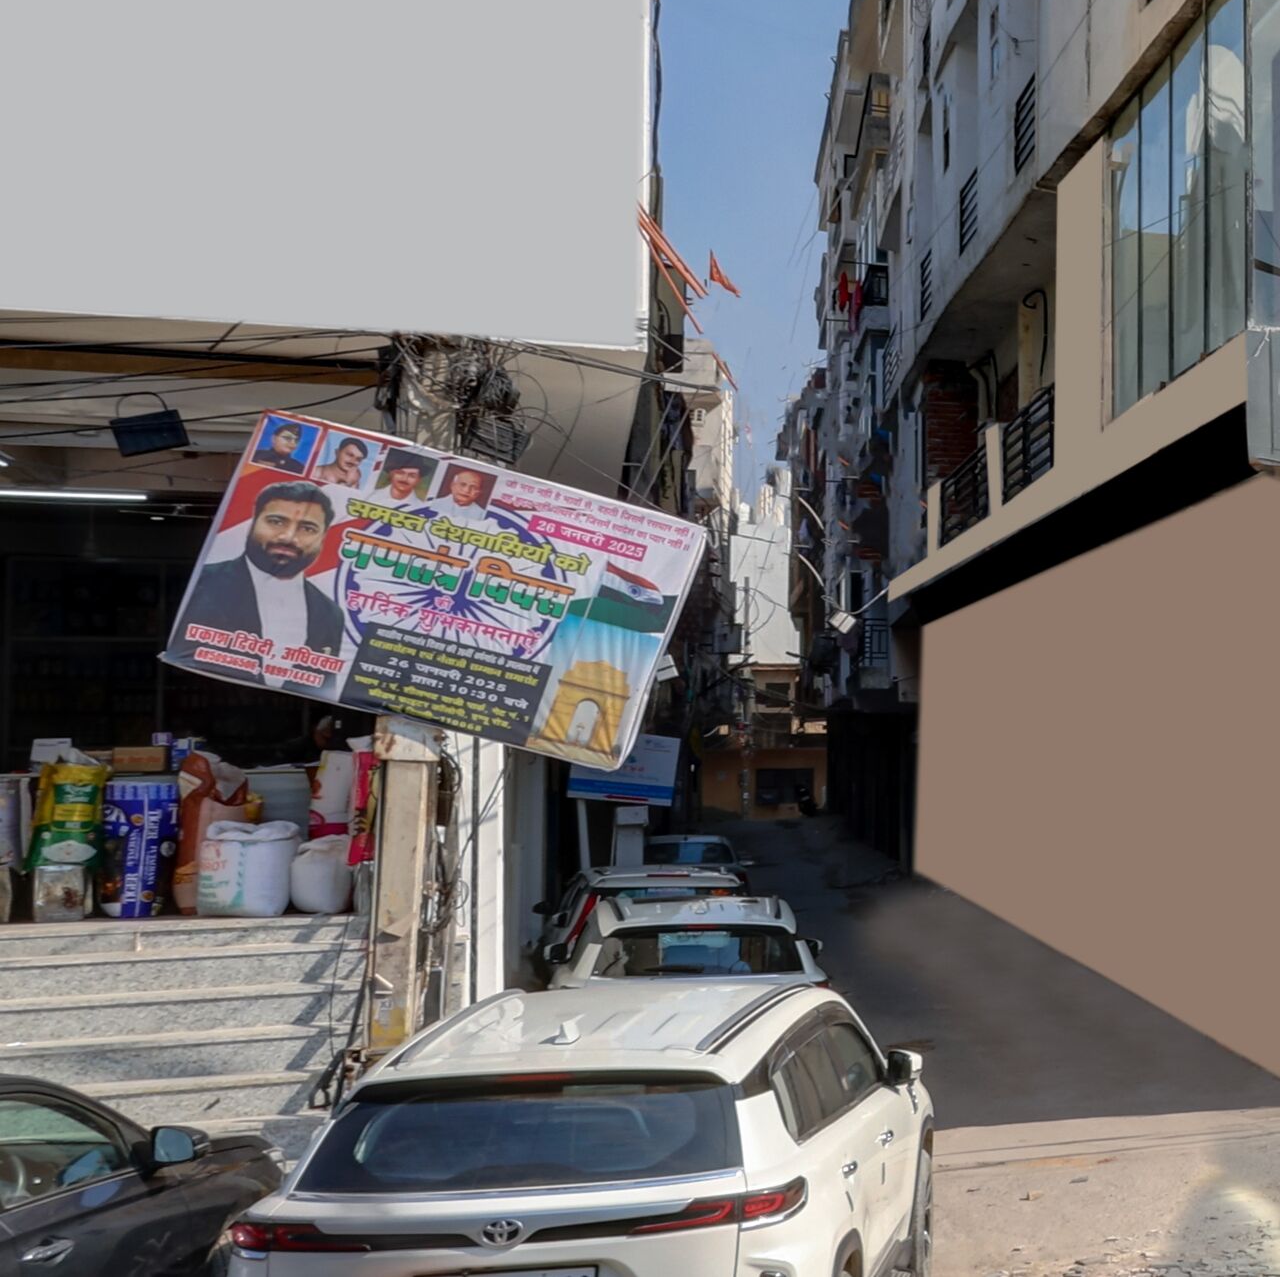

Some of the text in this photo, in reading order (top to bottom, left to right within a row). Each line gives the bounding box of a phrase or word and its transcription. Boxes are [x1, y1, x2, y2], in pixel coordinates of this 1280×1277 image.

[346, 498, 593, 575] समस्त देशवासियों को
[536, 519, 643, 558] 26 जनवरी 2025
[341, 531, 576, 618] गणतंत्र दिवस
[347, 590, 411, 619] हार्दिक
[388, 657, 507, 693] 26 जनवरी 2025
[503, 694, 529, 710] बजे
